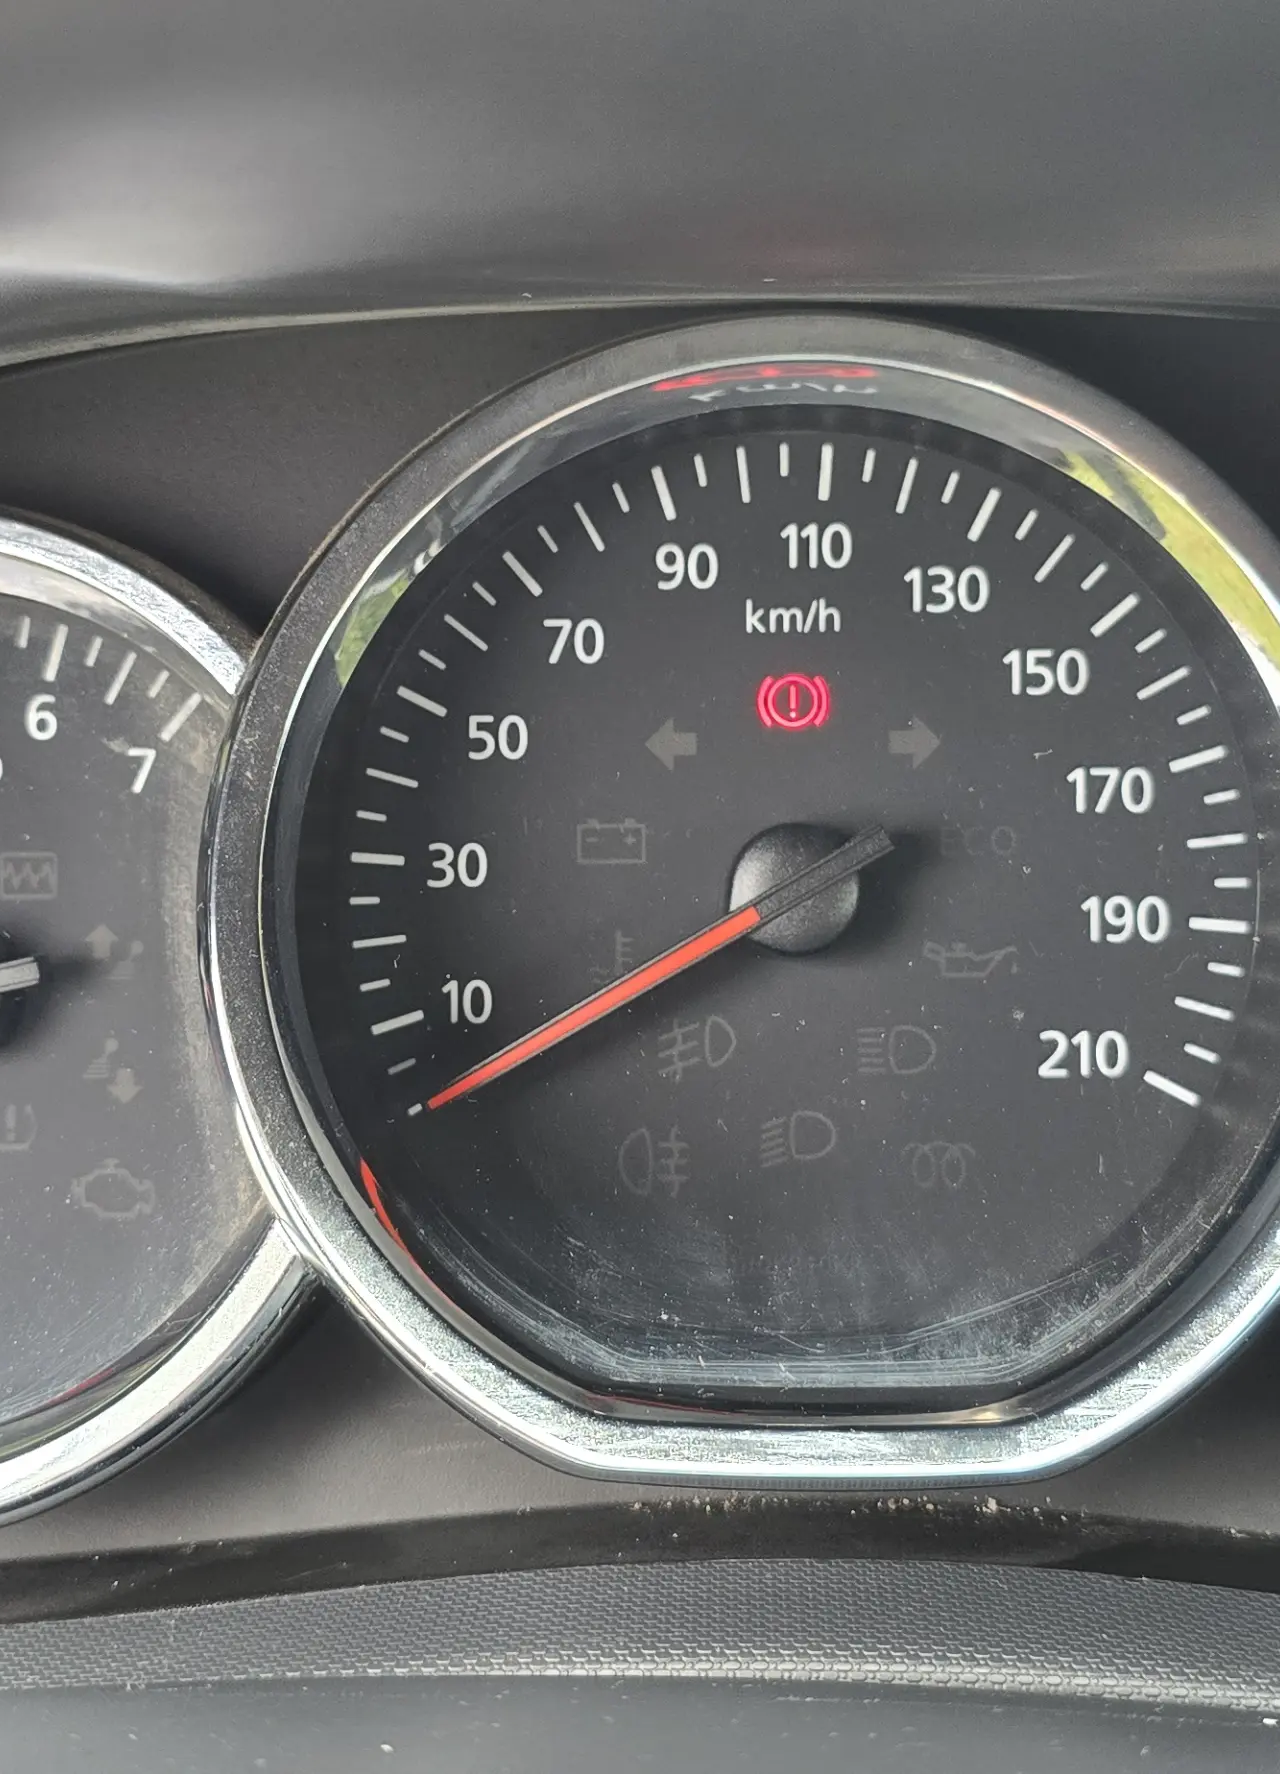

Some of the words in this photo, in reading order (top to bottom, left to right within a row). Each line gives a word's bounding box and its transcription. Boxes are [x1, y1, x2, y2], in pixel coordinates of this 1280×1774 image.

[655, 544, 719, 591] 90
[780, 523, 853, 569] 110
[903, 565, 990, 613] 130
[744, 598, 841, 635] km/h
[543, 618, 605, 665] 70
[1002, 649, 1090, 696] 150
[24, 694, 58, 741] 6
[467, 714, 529, 761] 50
[125, 747, 157, 794] 7
[1065, 767, 1154, 814] 170
[426, 842, 489, 888] 30
[1080, 895, 1170, 943] 190
[440, 979, 493, 1024] 10
[1037, 1029, 1130, 1078] 210
